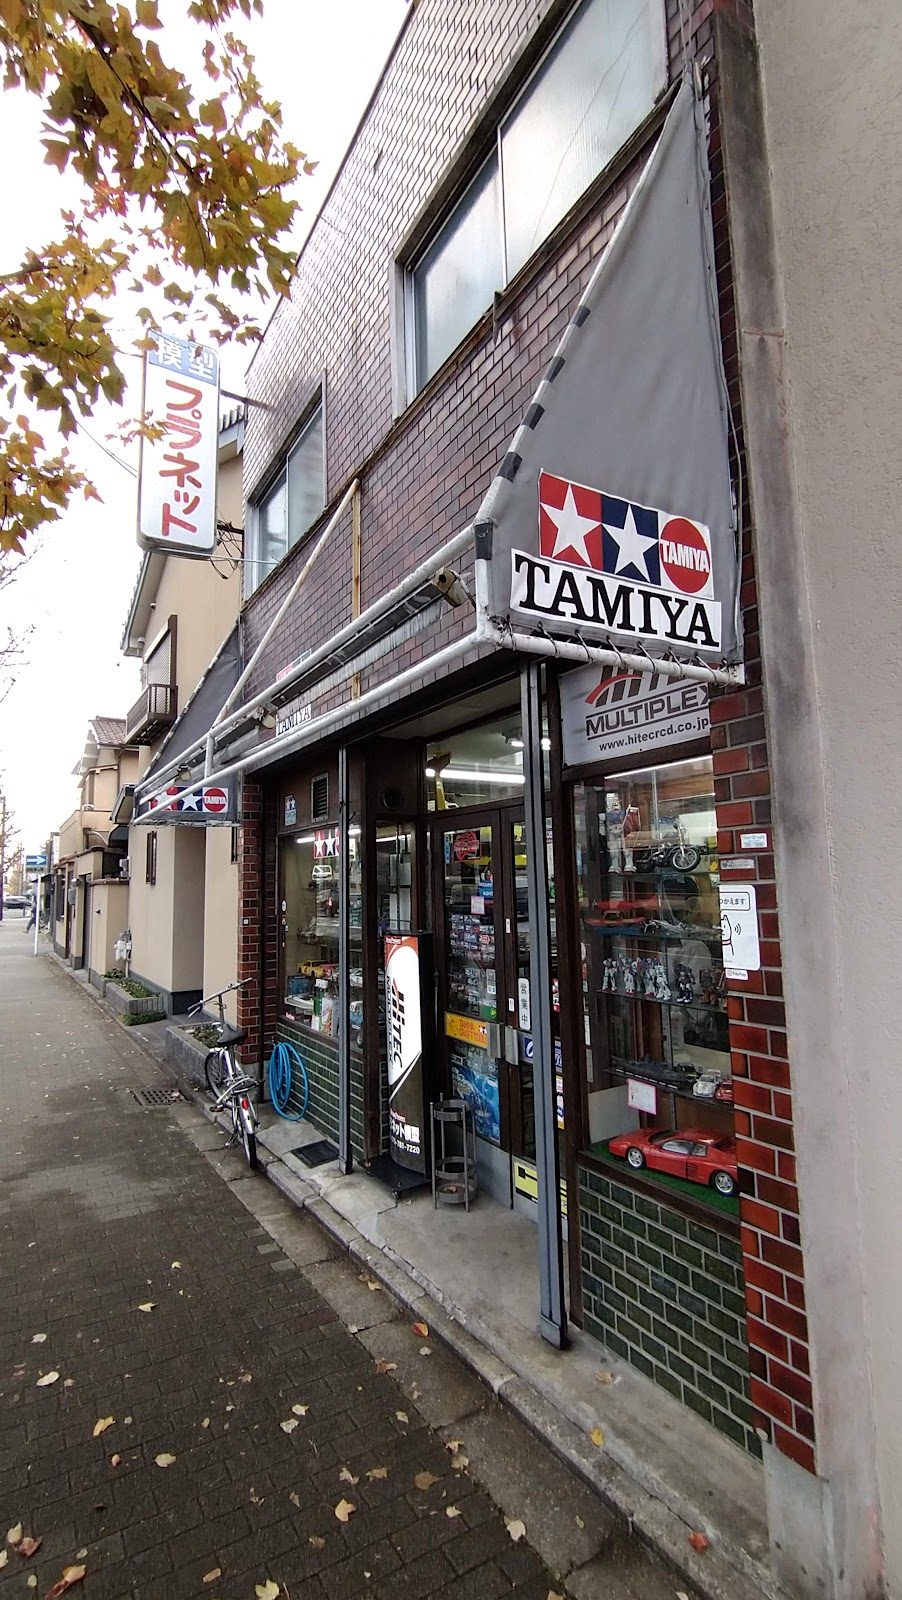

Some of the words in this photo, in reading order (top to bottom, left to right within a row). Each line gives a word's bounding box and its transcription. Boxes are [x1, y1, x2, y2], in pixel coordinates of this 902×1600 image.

[154, 337, 214, 380] 模型
[159, 379, 203, 536] プラネット
[659, 539, 710, 573] TAMIYA
[514, 553, 720, 648] TAMIYA
[599, 717, 709, 751] www.hitecrcd.co.jp
[203, 795, 227, 805] TAMIYA
[520, 983, 529, 1025] 営業中
